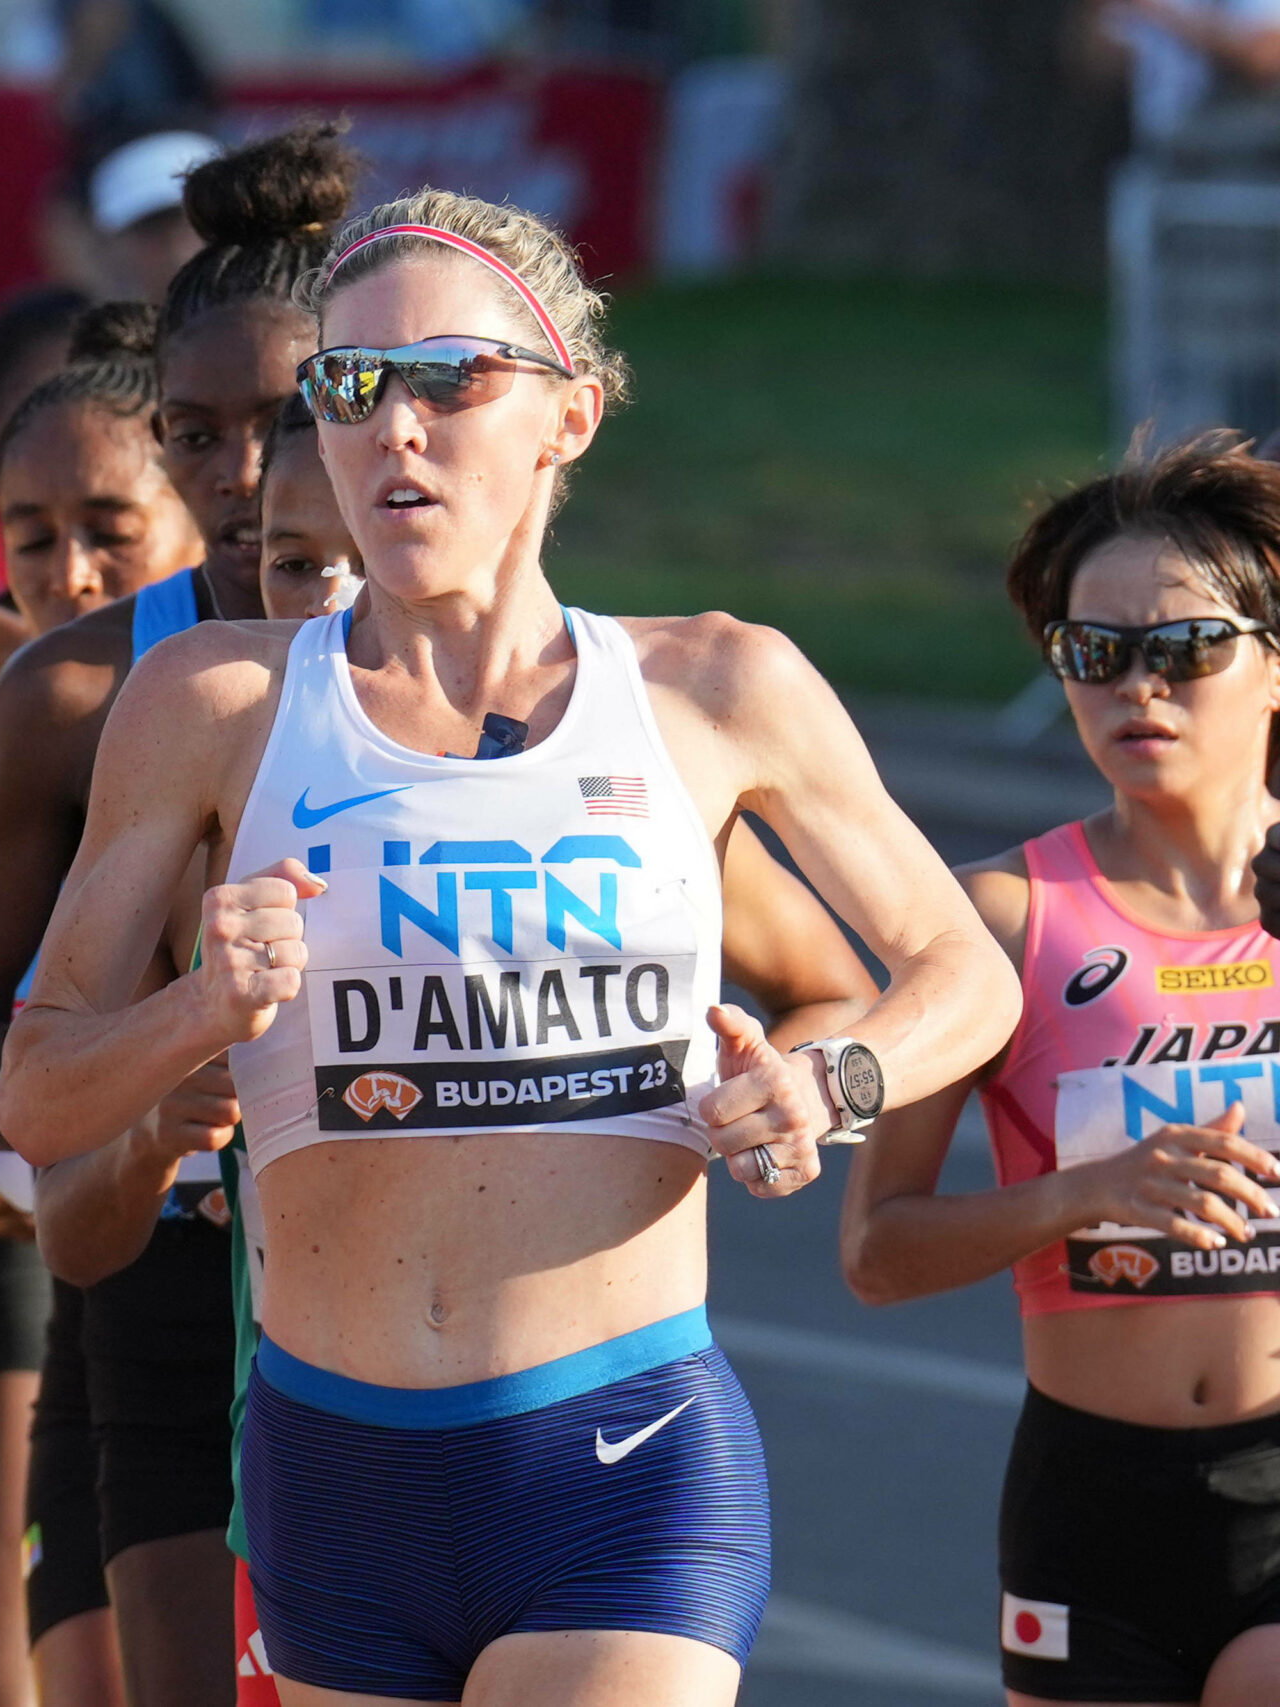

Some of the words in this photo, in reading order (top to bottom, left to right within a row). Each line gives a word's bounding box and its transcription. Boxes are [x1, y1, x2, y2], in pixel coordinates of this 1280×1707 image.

[379, 869, 623, 958] NTN
[332, 962, 670, 1053] D'AMATO
[1160, 964, 1267, 988] SEIKO
[436, 1066, 633, 1107] BUDAPEST
[638, 1059, 669, 1091] 23
[1122, 1061, 1280, 1142] NT
